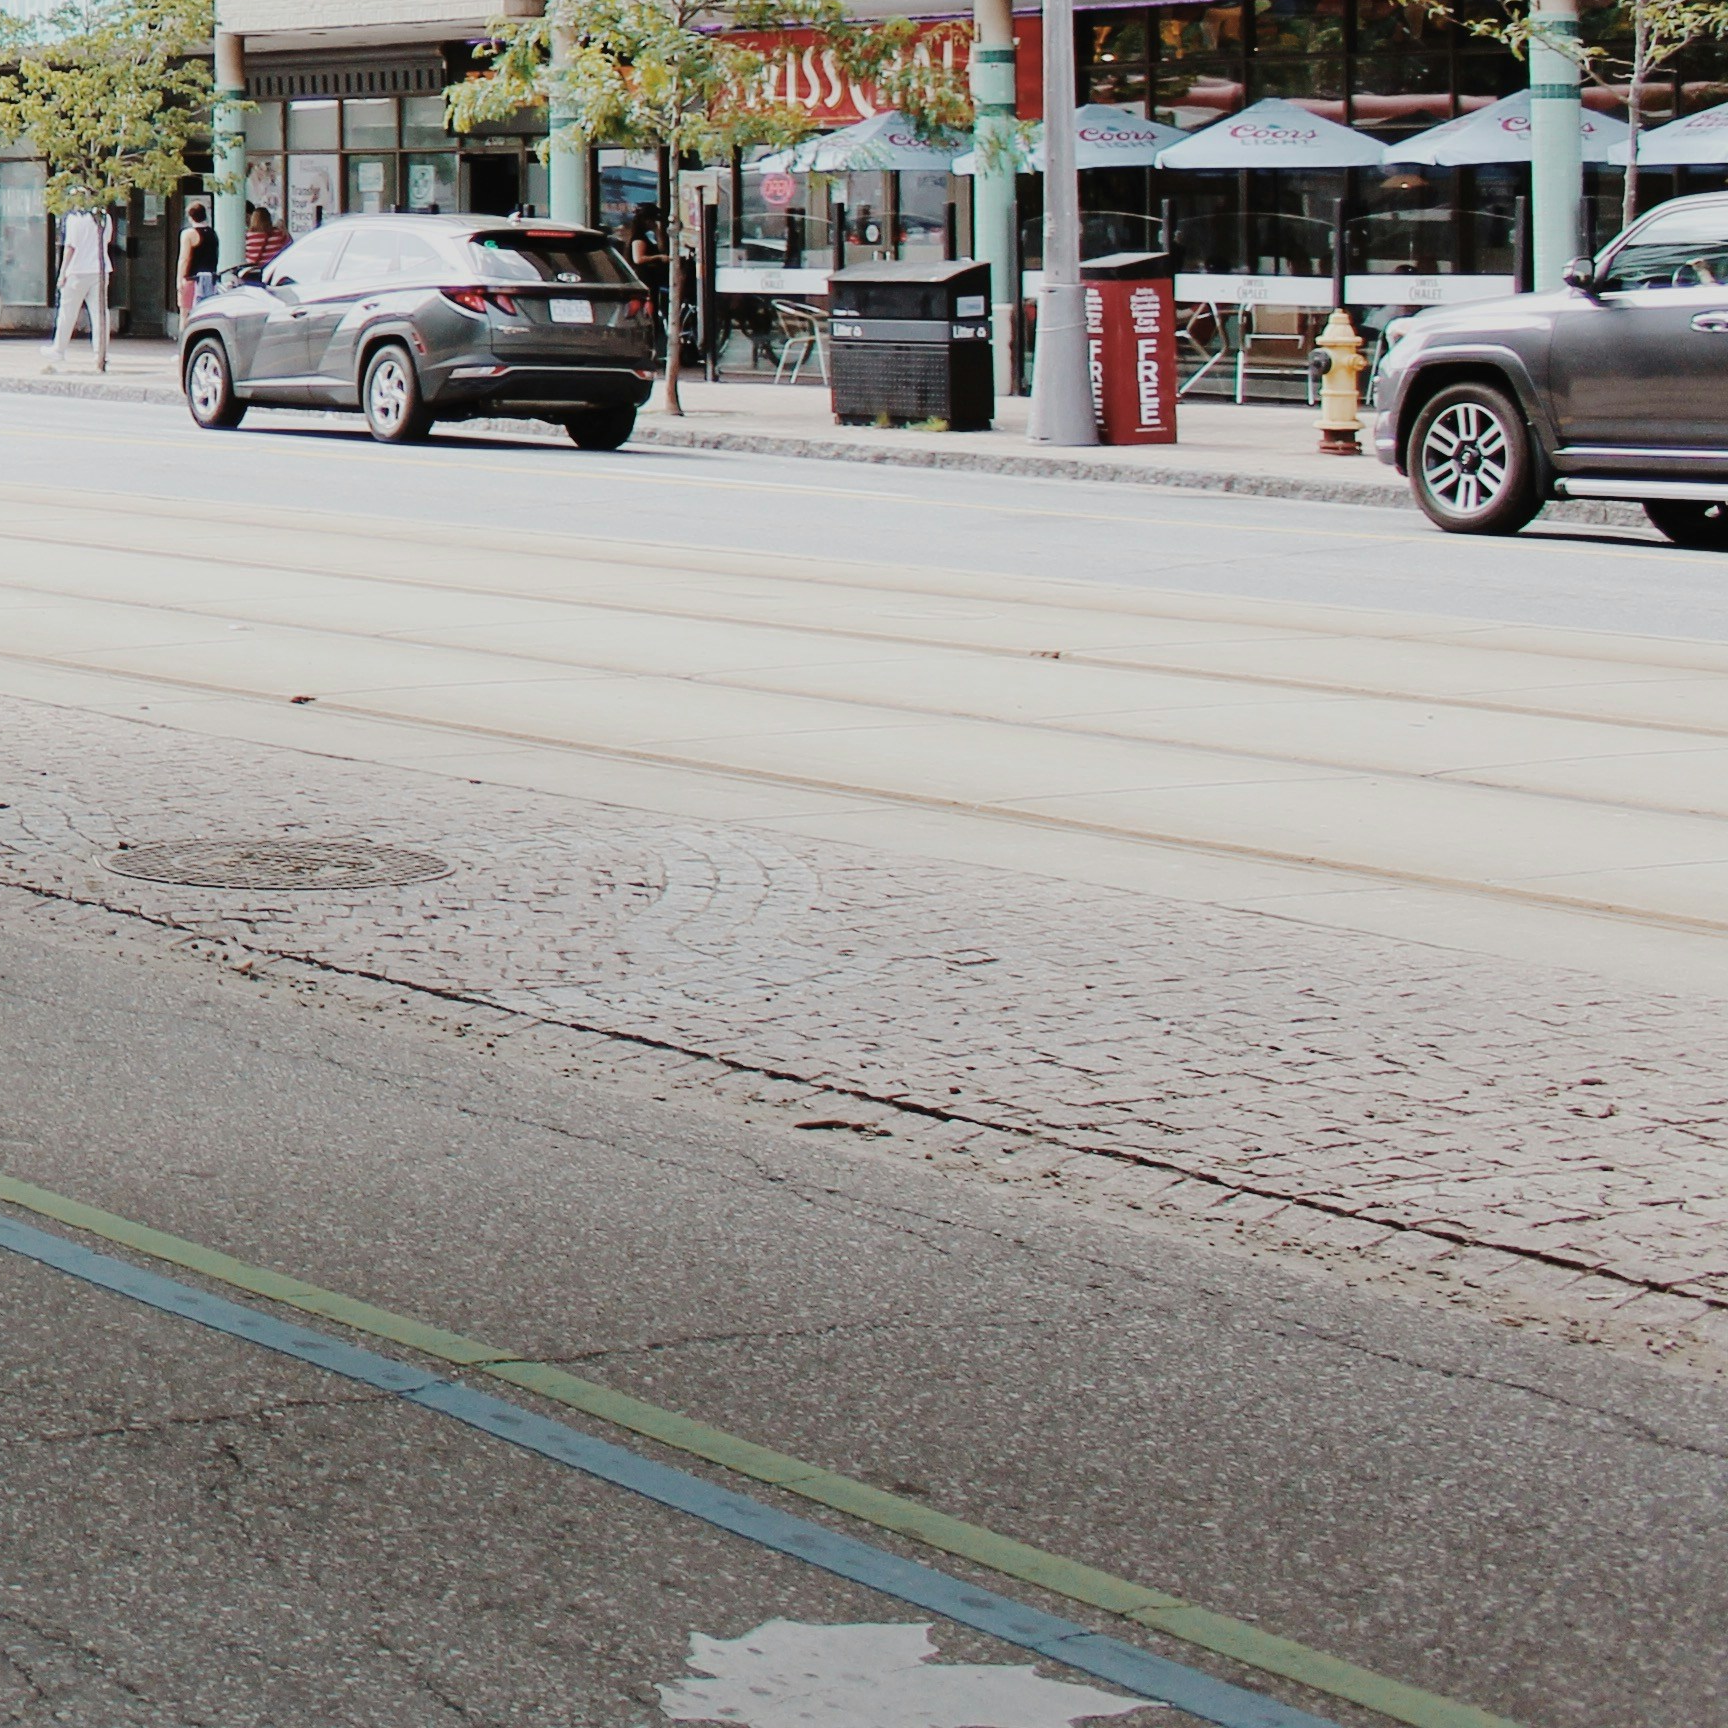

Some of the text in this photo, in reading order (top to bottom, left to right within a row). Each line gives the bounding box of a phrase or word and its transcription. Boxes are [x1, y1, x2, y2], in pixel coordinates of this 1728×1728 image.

[1079, 126, 1159, 142] Coors
[1230, 124, 1319, 139] Coors
[1094, 140, 1156, 149] LIGHT
[1240, 138, 1309, 147] LIGHT
[1409, 286, 1442, 299] CHALET
[1137, 338, 1162, 425] FREE
